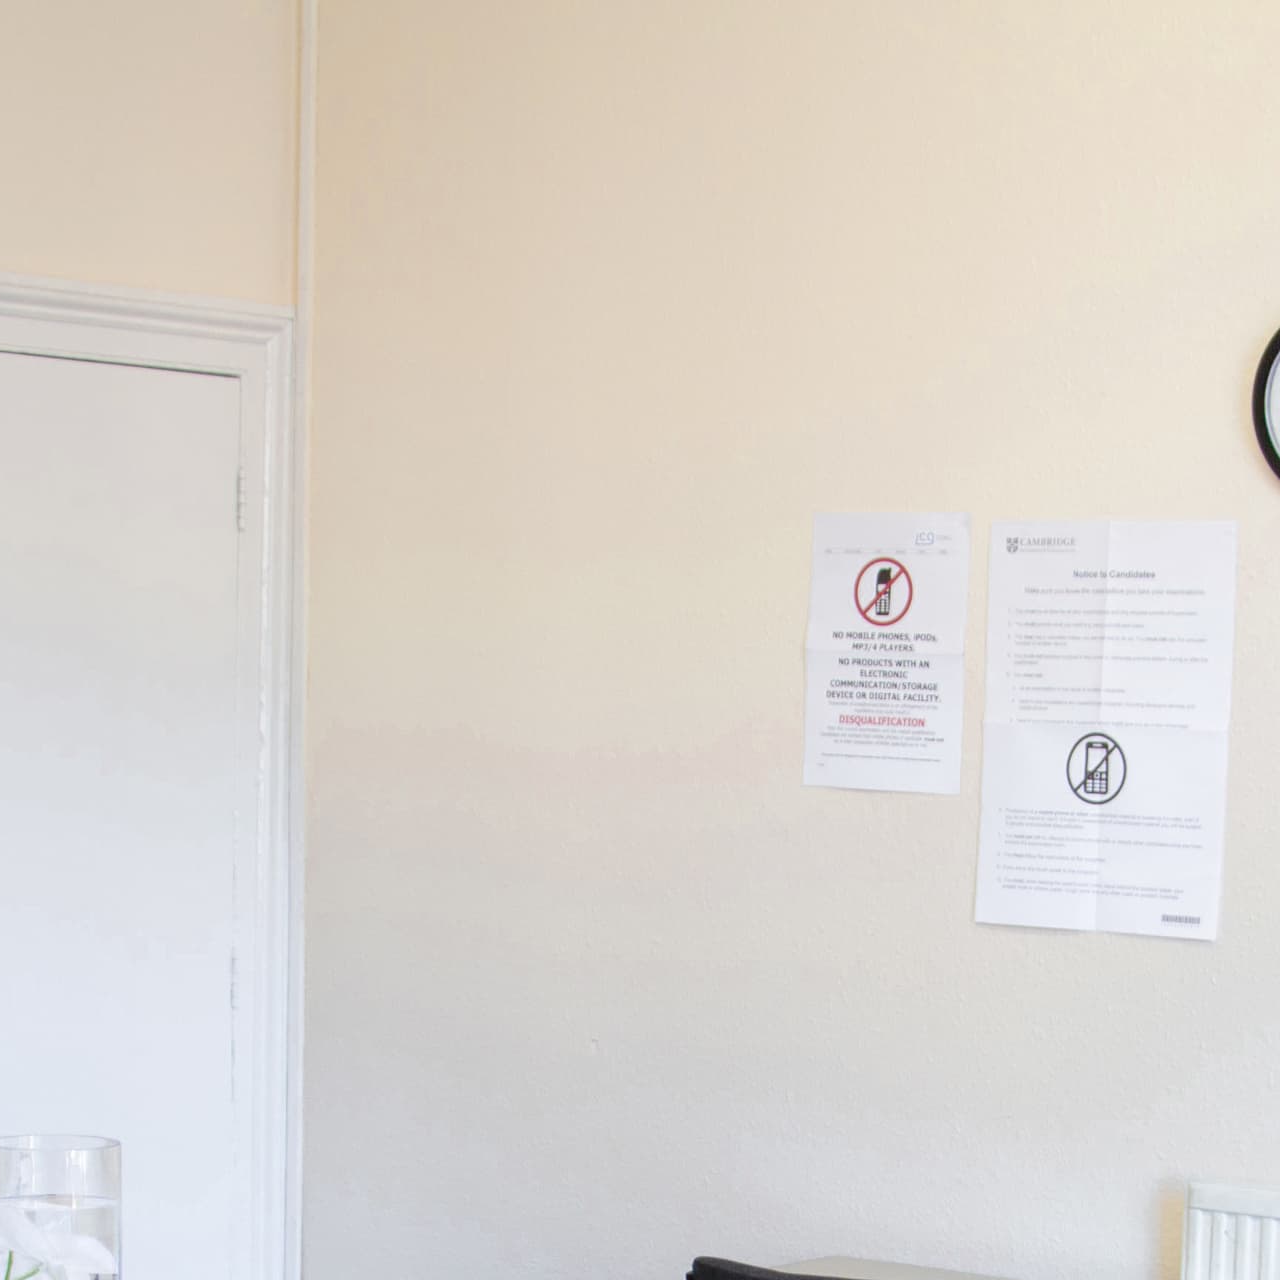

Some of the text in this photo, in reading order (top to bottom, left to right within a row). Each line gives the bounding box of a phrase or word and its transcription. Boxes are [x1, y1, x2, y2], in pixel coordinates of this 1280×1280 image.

[1019, 536, 1077, 546] CAMBRIDGE
[1072, 569, 1156, 579] Notice to Candidates
[832, 631, 844, 639] NO
[846, 631, 875, 640] MOBILE
[877, 632, 912, 642] PHONES,
[852, 642, 877, 652] MP3/4
[838, 657, 930, 669] NO PRODUCTS WITH AN
[859, 669, 908, 679] ELECTRONIC
[830, 679, 938, 691] COMMUNICATION/STORAGE
[826, 690, 854, 699] DEVICE
[856, 690, 866, 700] OR
[868, 691, 901, 701] DIGITAL
[839, 714, 926, 728] DISQUALIFICATION
